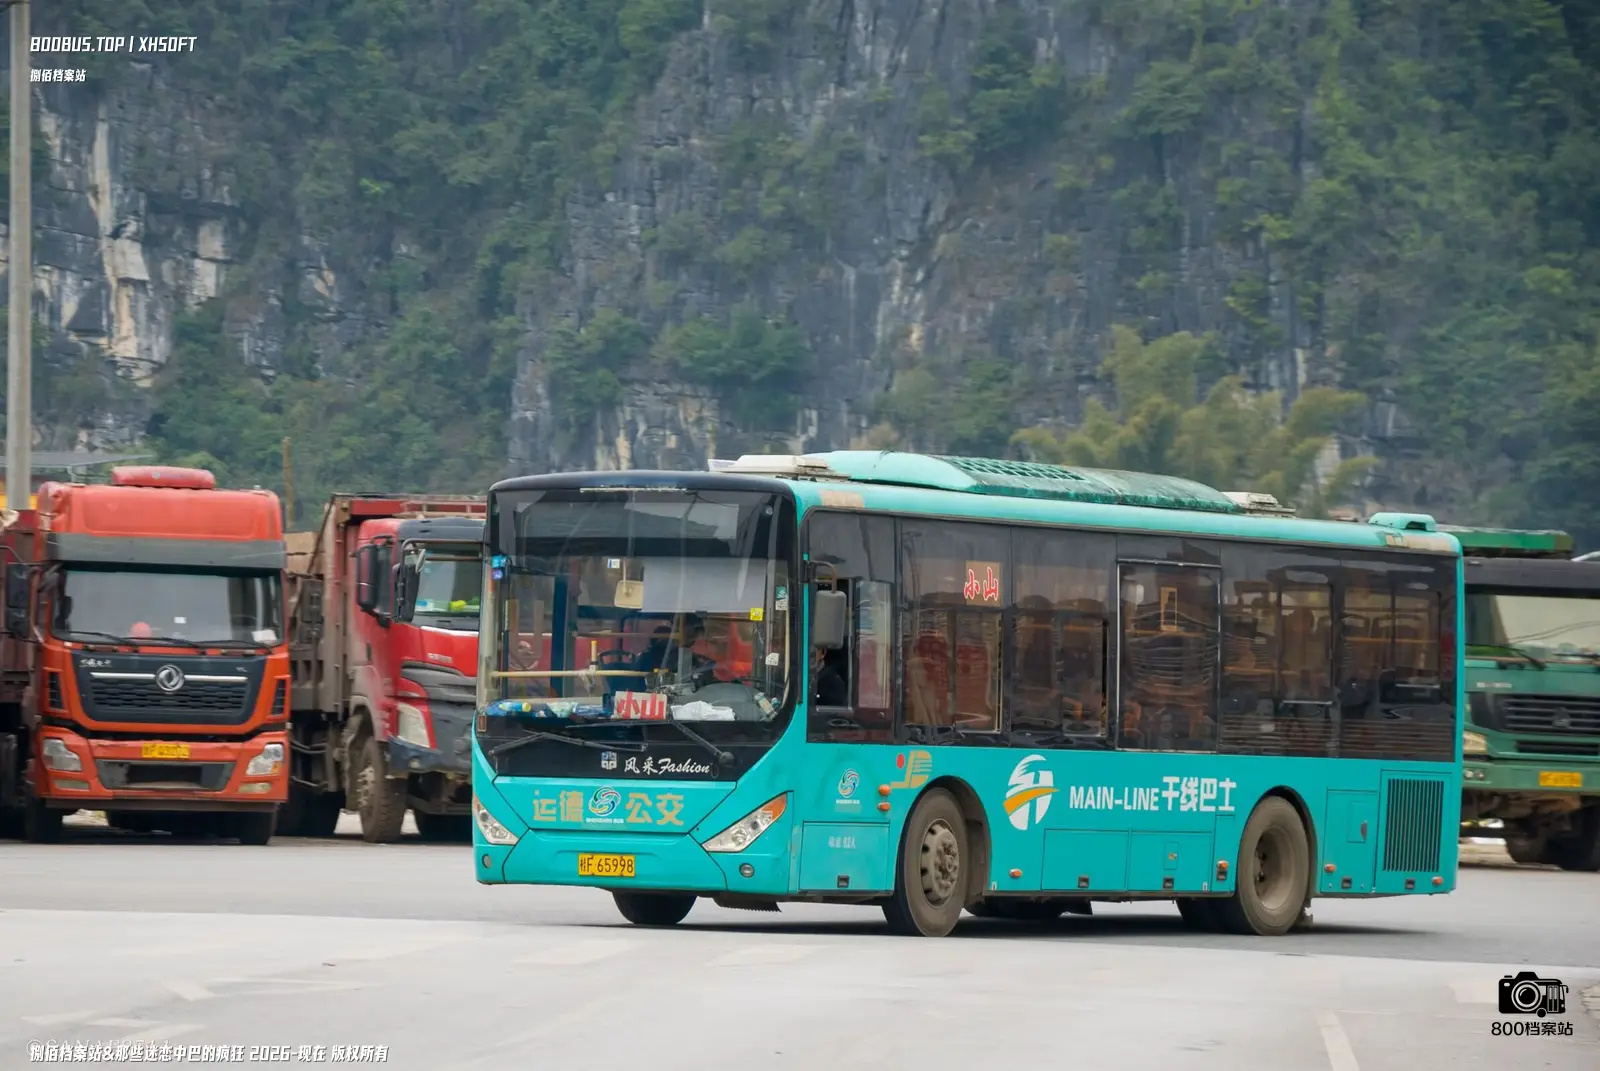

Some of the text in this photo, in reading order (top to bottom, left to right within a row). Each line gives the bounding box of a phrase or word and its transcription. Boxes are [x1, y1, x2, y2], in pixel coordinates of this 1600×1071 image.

[964, 566, 999, 601] 小山
[616, 690, 664, 720] 小山
[624, 756, 710, 775] 风采 Fashion
[533, 789, 684, 826] 运德 公交
[1069, 776, 1237, 812] MAIN-LINE 干线巴士
[597, 858, 634, 873] 65998
